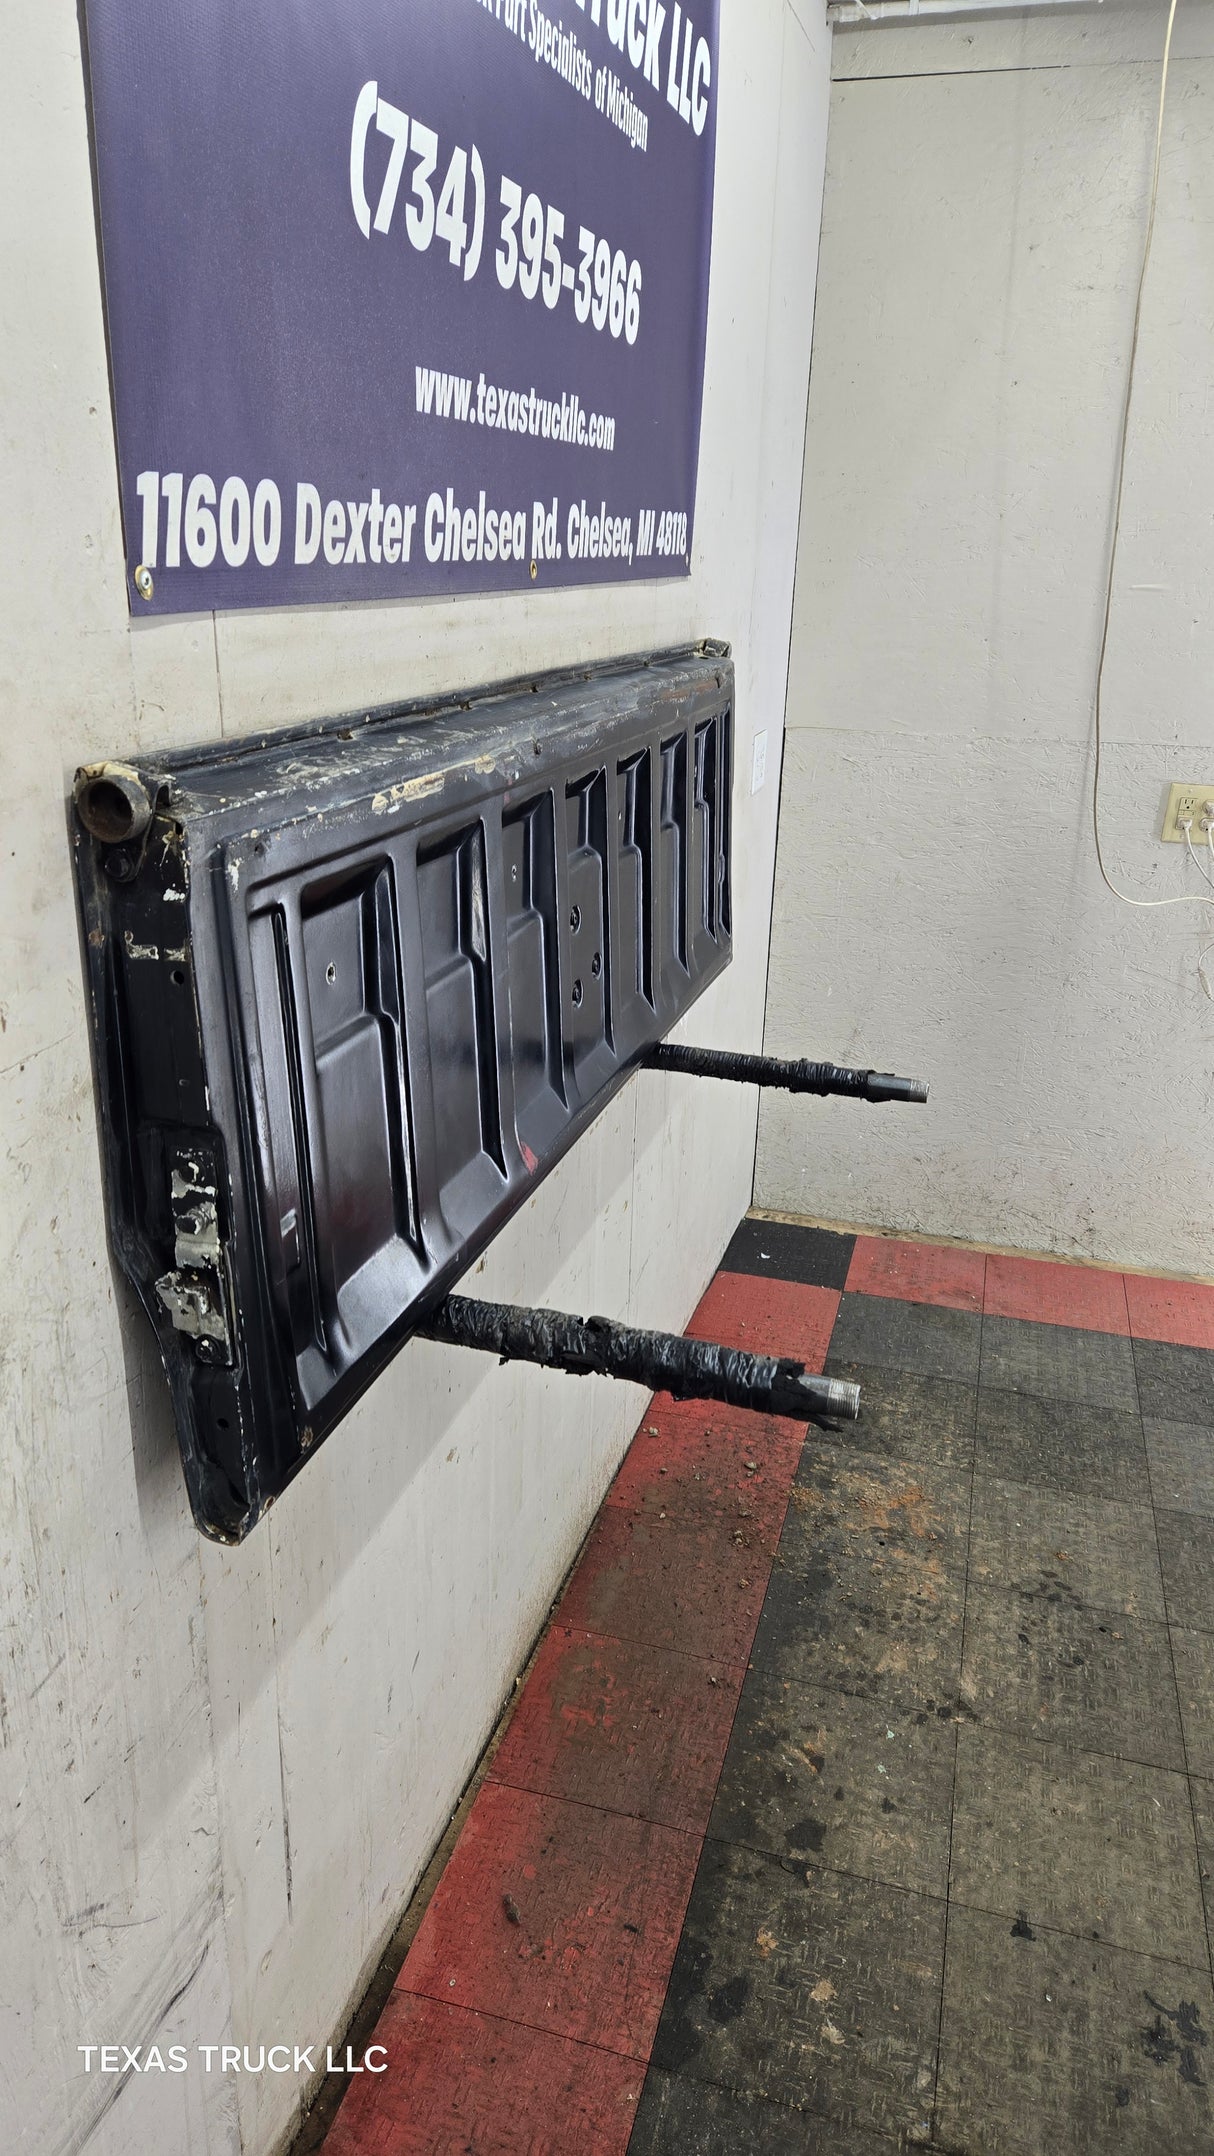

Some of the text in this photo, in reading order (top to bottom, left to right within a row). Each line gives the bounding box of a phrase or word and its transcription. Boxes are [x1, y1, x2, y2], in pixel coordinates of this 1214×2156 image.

[528, 0, 592, 100] Specialists
[595, 66, 608, 113] of
[606, 69, 648, 152] Michigan
[667, 1, 711, 136] LLC
[350, 80, 642, 345] (734) 395-3966
[415, 366, 616, 451] www.texastruckllc.com
[136, 471, 687, 568] 11600 Dexter Chelsea Rd. Chelsea, MI 48118
